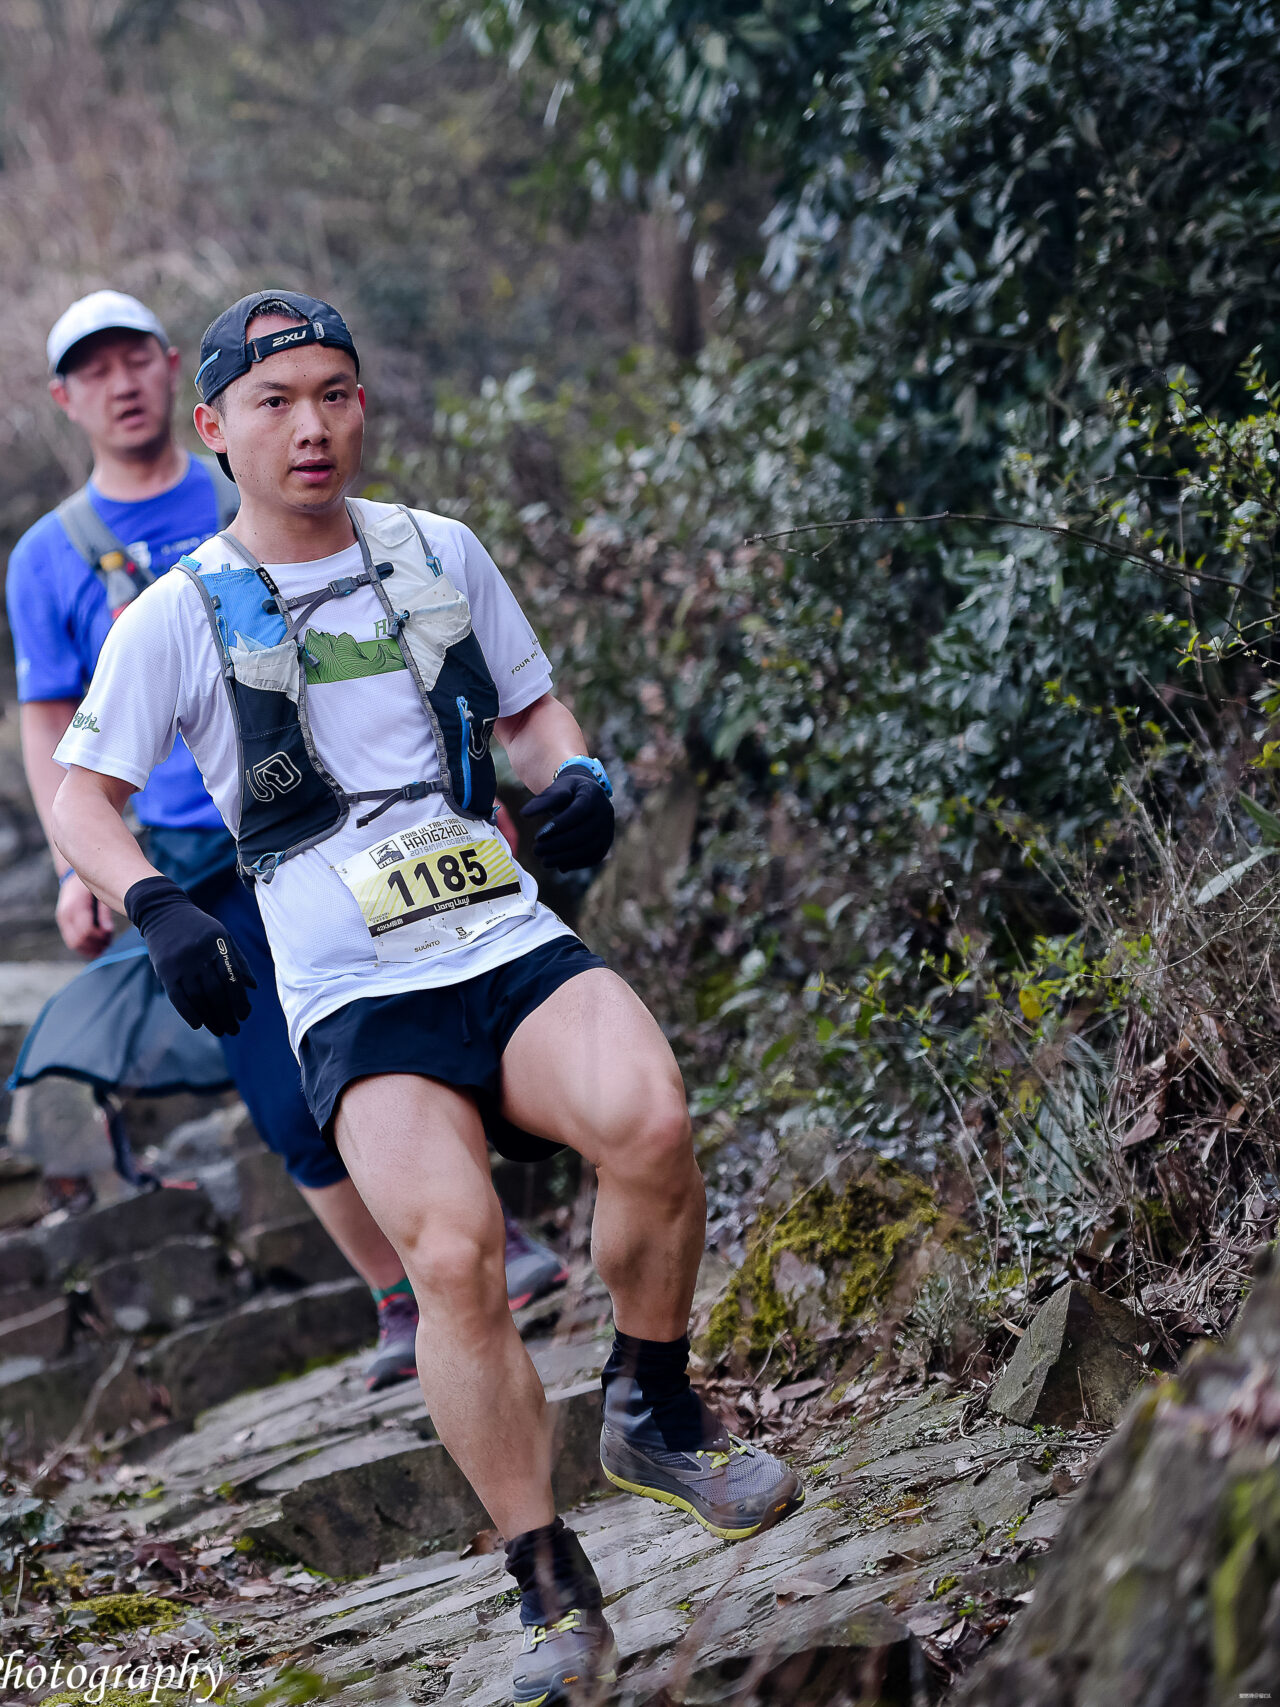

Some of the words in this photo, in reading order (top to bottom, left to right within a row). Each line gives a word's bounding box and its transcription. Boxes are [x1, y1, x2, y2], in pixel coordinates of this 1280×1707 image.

[272, 330, 307, 348] 2XU
[400, 830, 418, 841] 2019
[403, 823, 469, 851] HANGZHOU
[387, 848, 488, 907] 1185
[414, 939, 441, 953] SUUNTO
